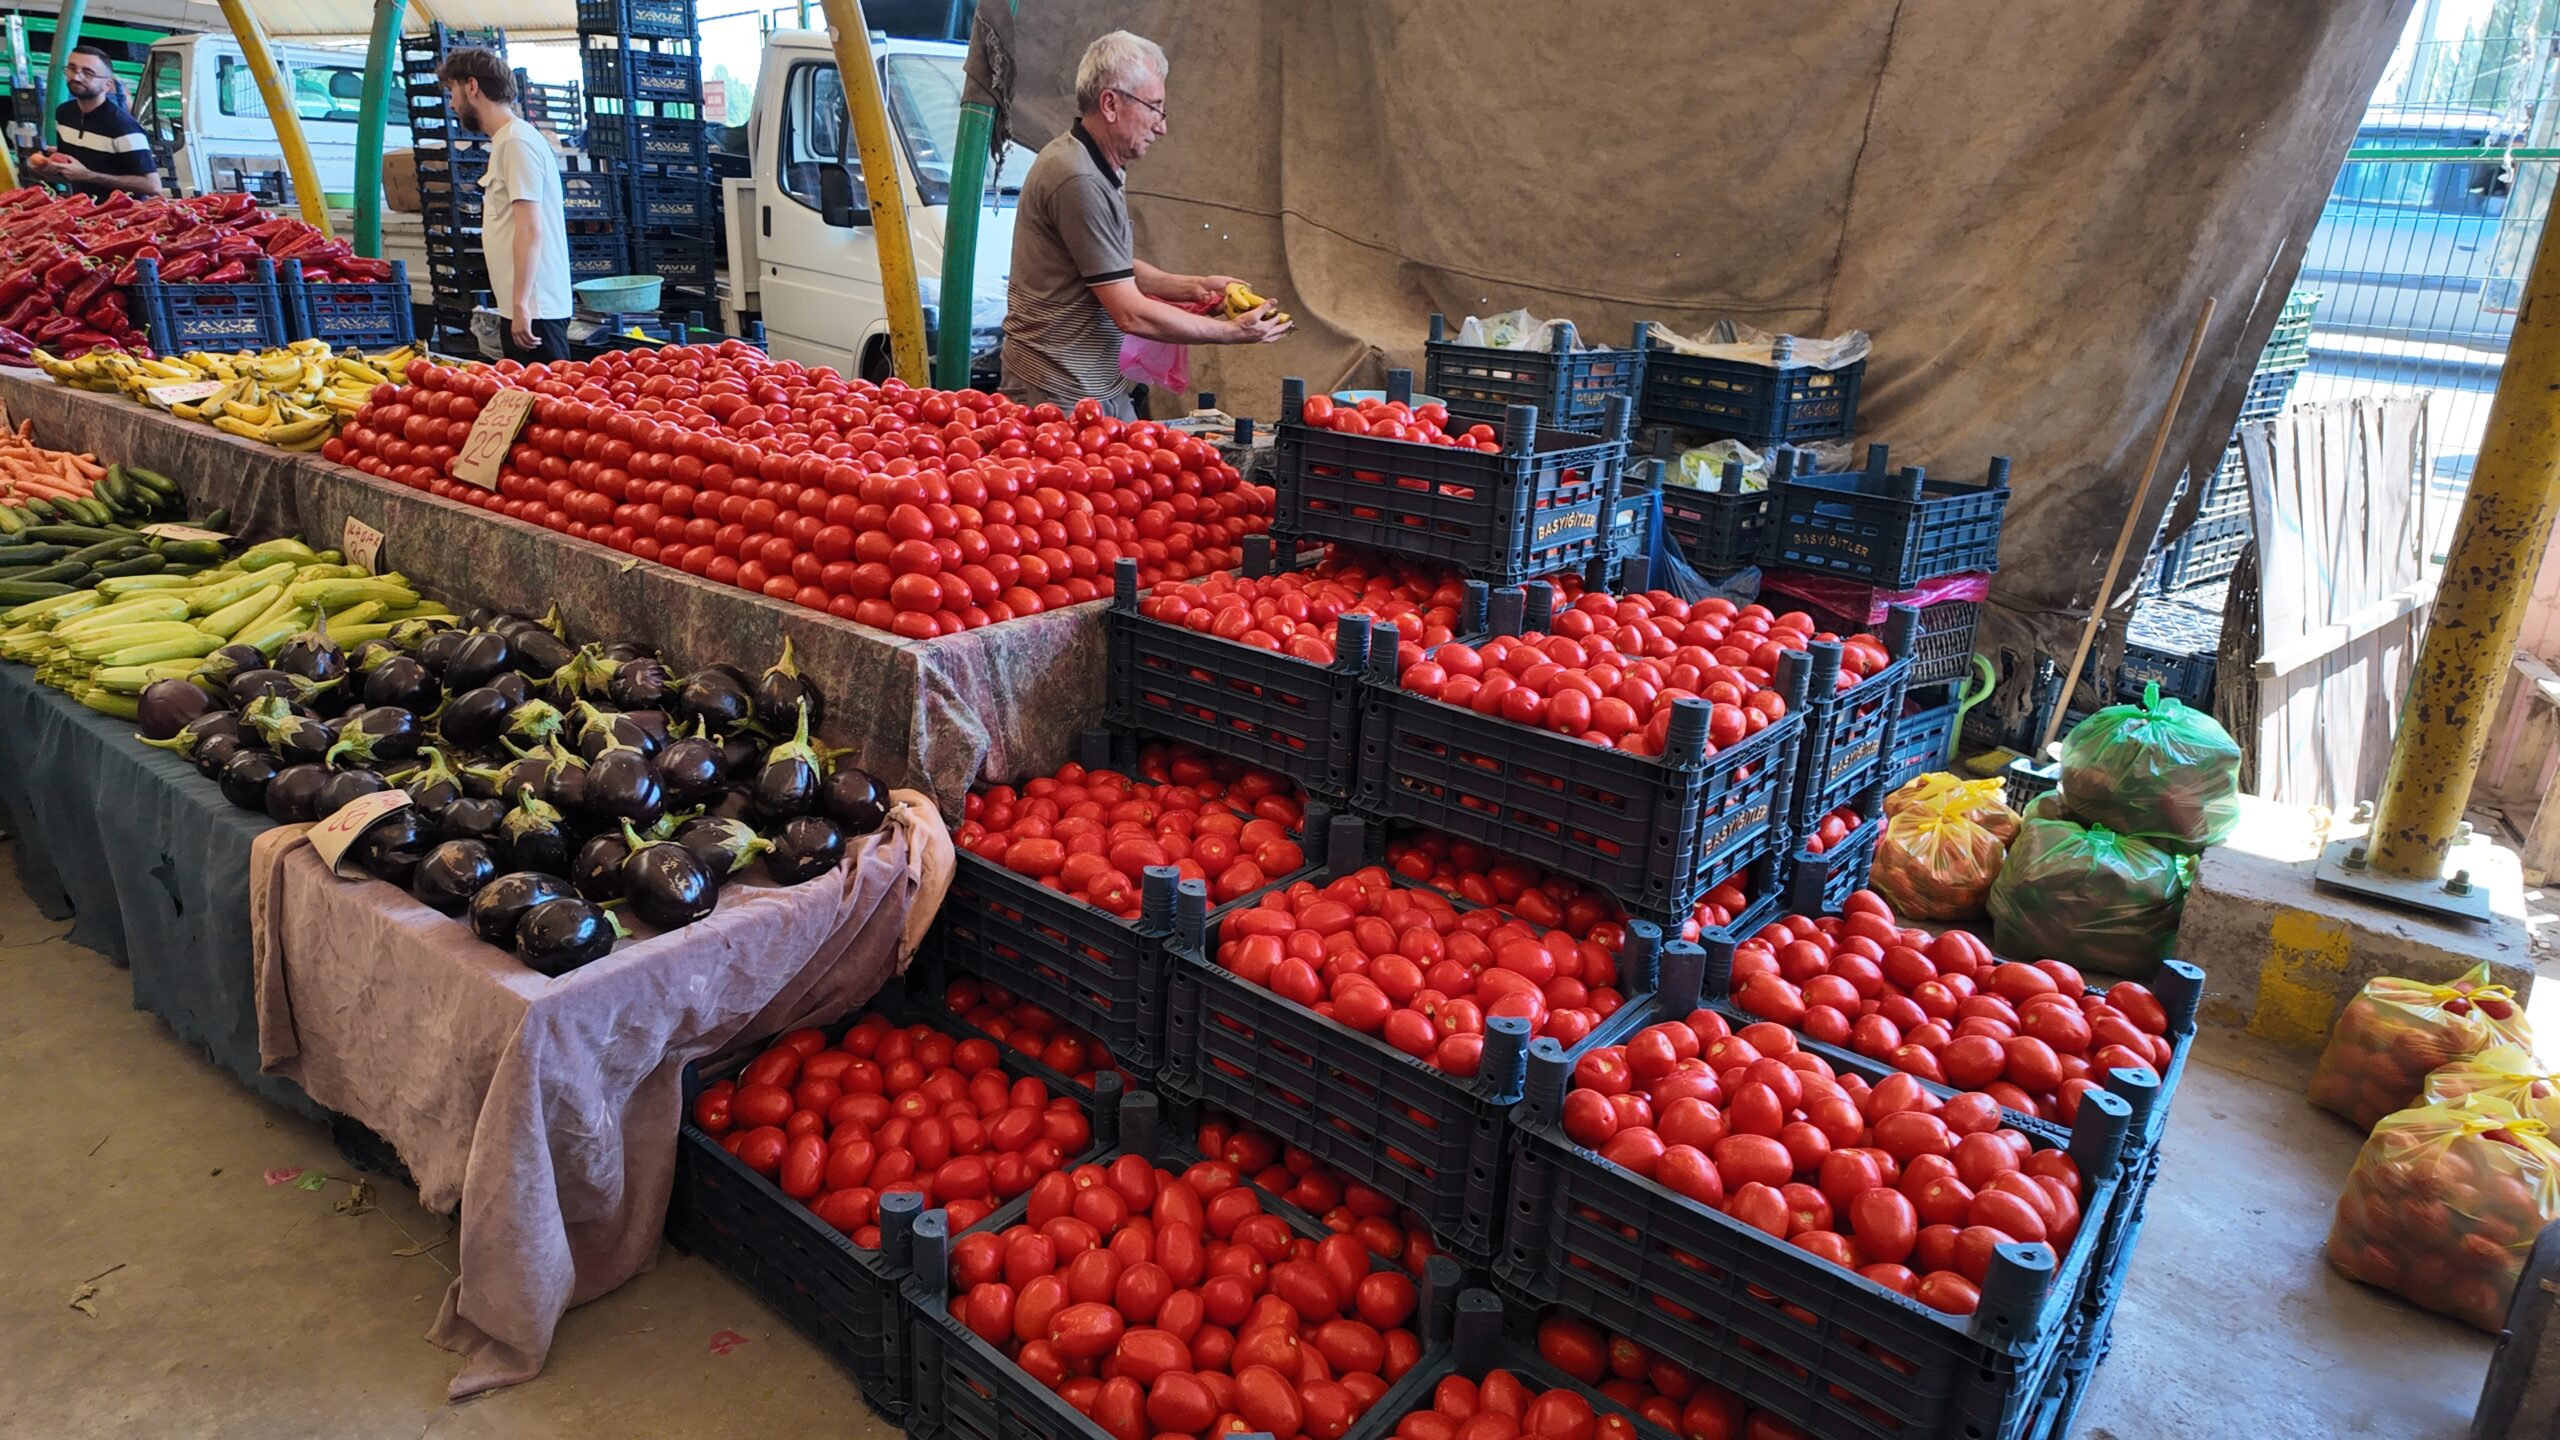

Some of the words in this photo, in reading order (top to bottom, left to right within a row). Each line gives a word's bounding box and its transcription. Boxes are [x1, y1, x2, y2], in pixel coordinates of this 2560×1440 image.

[635, 9, 681, 20] YAVUZ
[640, 76, 686, 86] YAVUZ
[646, 141, 689, 149] YAVUZ
[650, 203, 694, 211] YAVUZ
[183, 319, 257, 328] YAVUZ
[464, 430, 502, 466] 20
